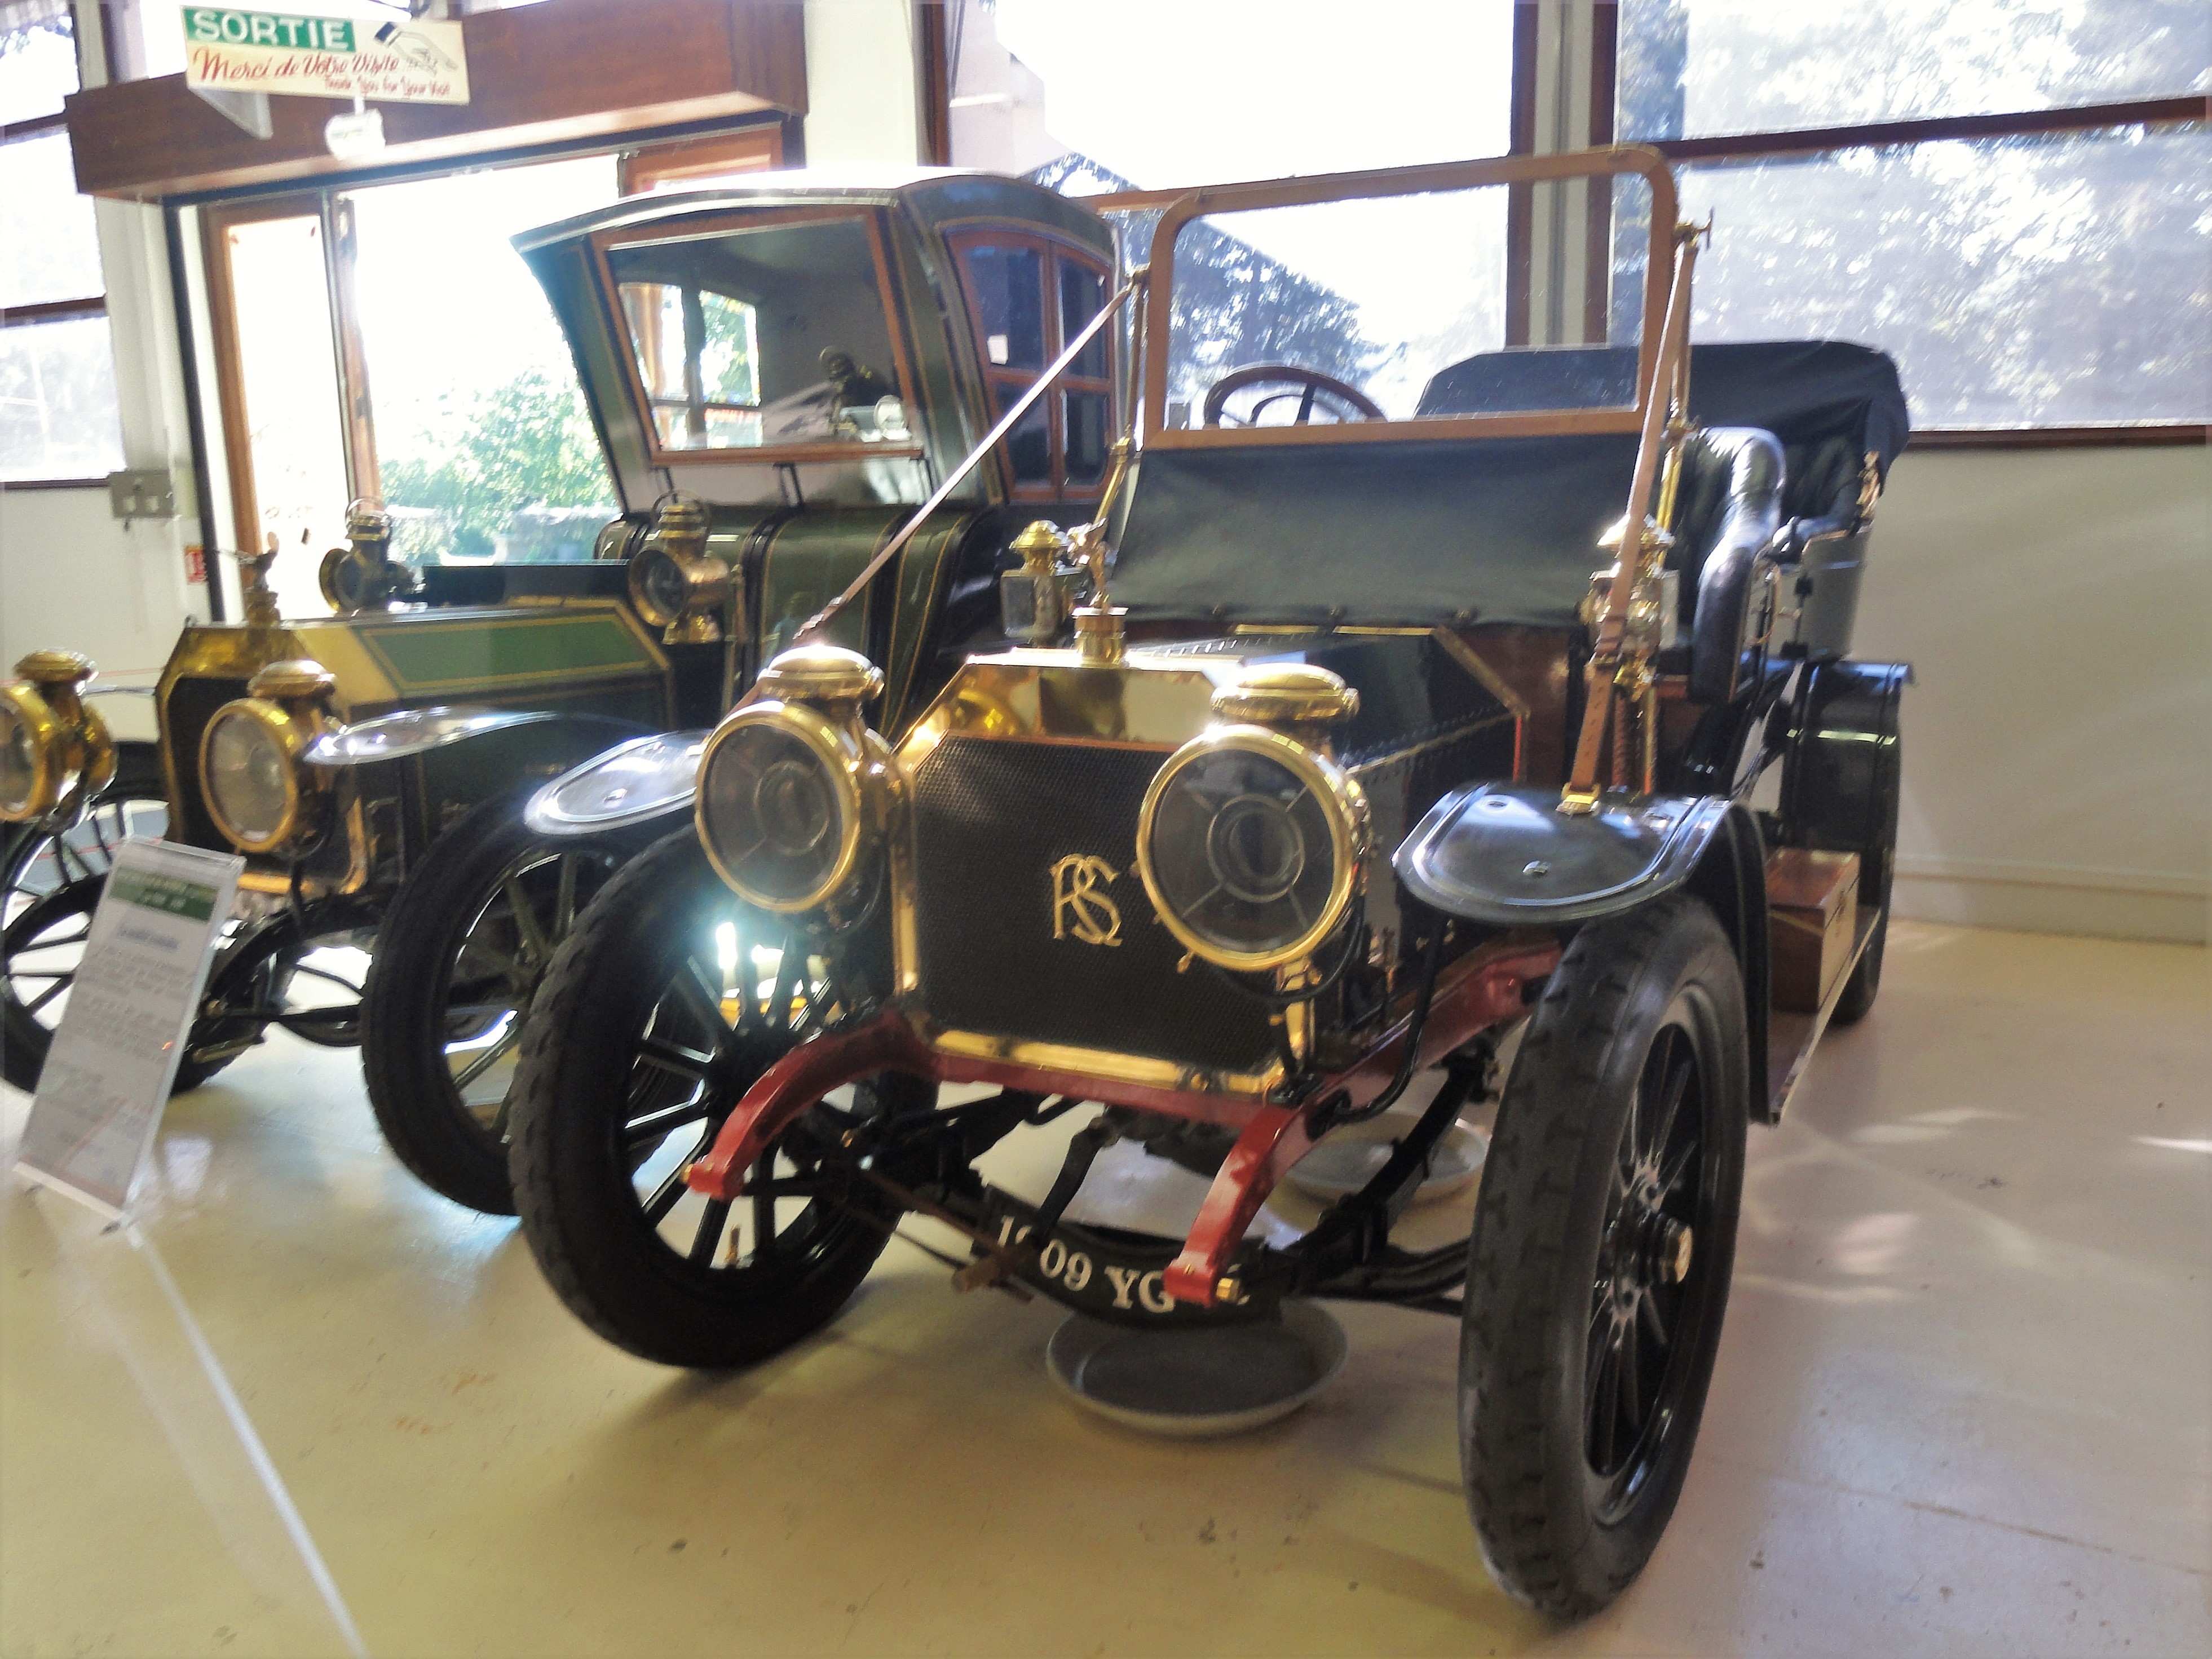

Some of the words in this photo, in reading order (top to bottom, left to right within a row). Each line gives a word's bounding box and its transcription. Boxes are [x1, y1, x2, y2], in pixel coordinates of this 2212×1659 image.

[193, 10, 348, 50] SORTIE
[193, 46, 273, 82] Merci
[275, 55, 299, 77] de
[303, 52, 348, 77] Votre
[352, 53, 399, 76] Visite
[997, 1215, 1093, 1291] 109
